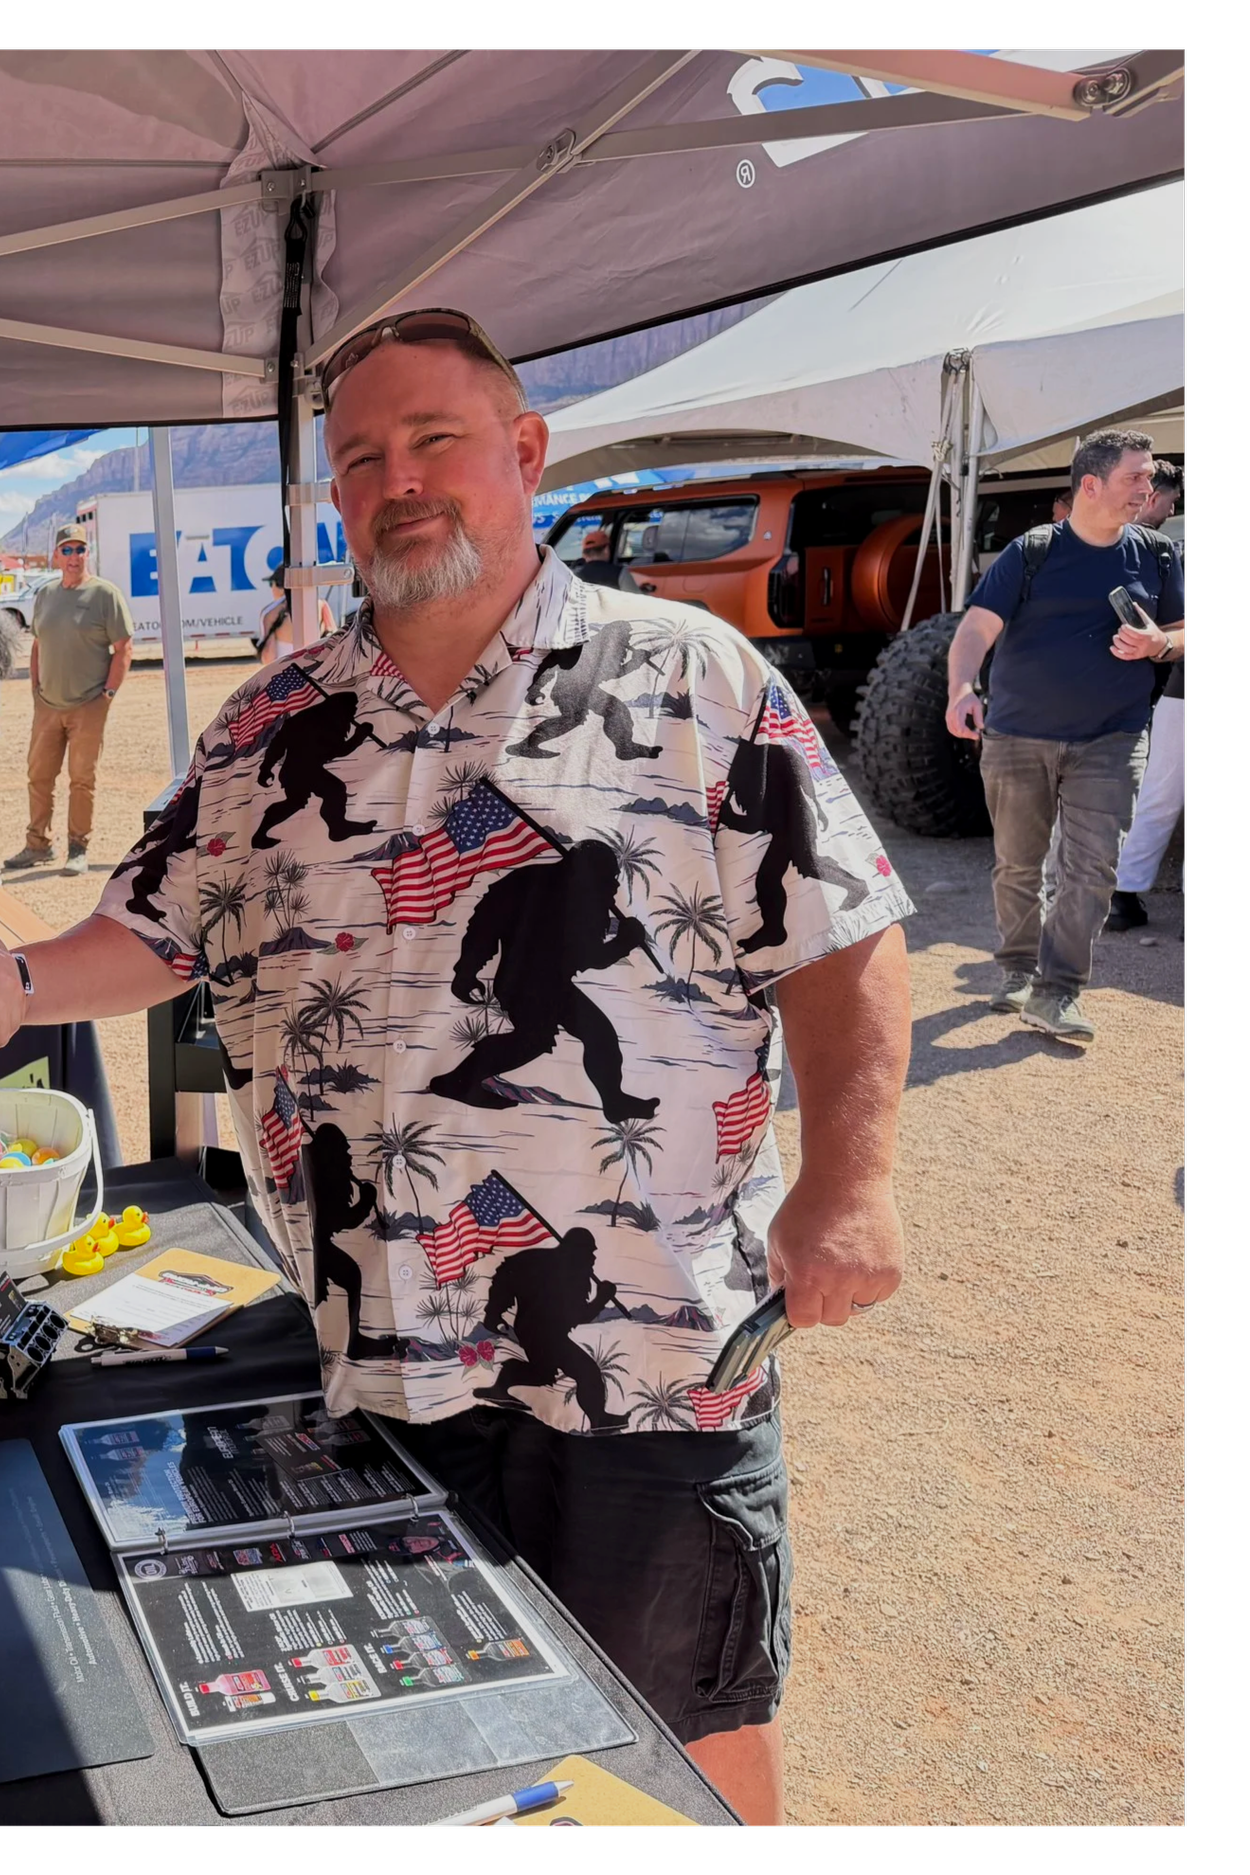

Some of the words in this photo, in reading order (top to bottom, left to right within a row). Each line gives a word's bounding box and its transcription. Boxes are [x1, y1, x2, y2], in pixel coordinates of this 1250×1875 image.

[76, 1625, 97, 1667] Automotive
[368, 1653, 387, 1673] RACE
[277, 1671, 300, 1702] CRUISE
[181, 1691, 201, 1717] BUILD
